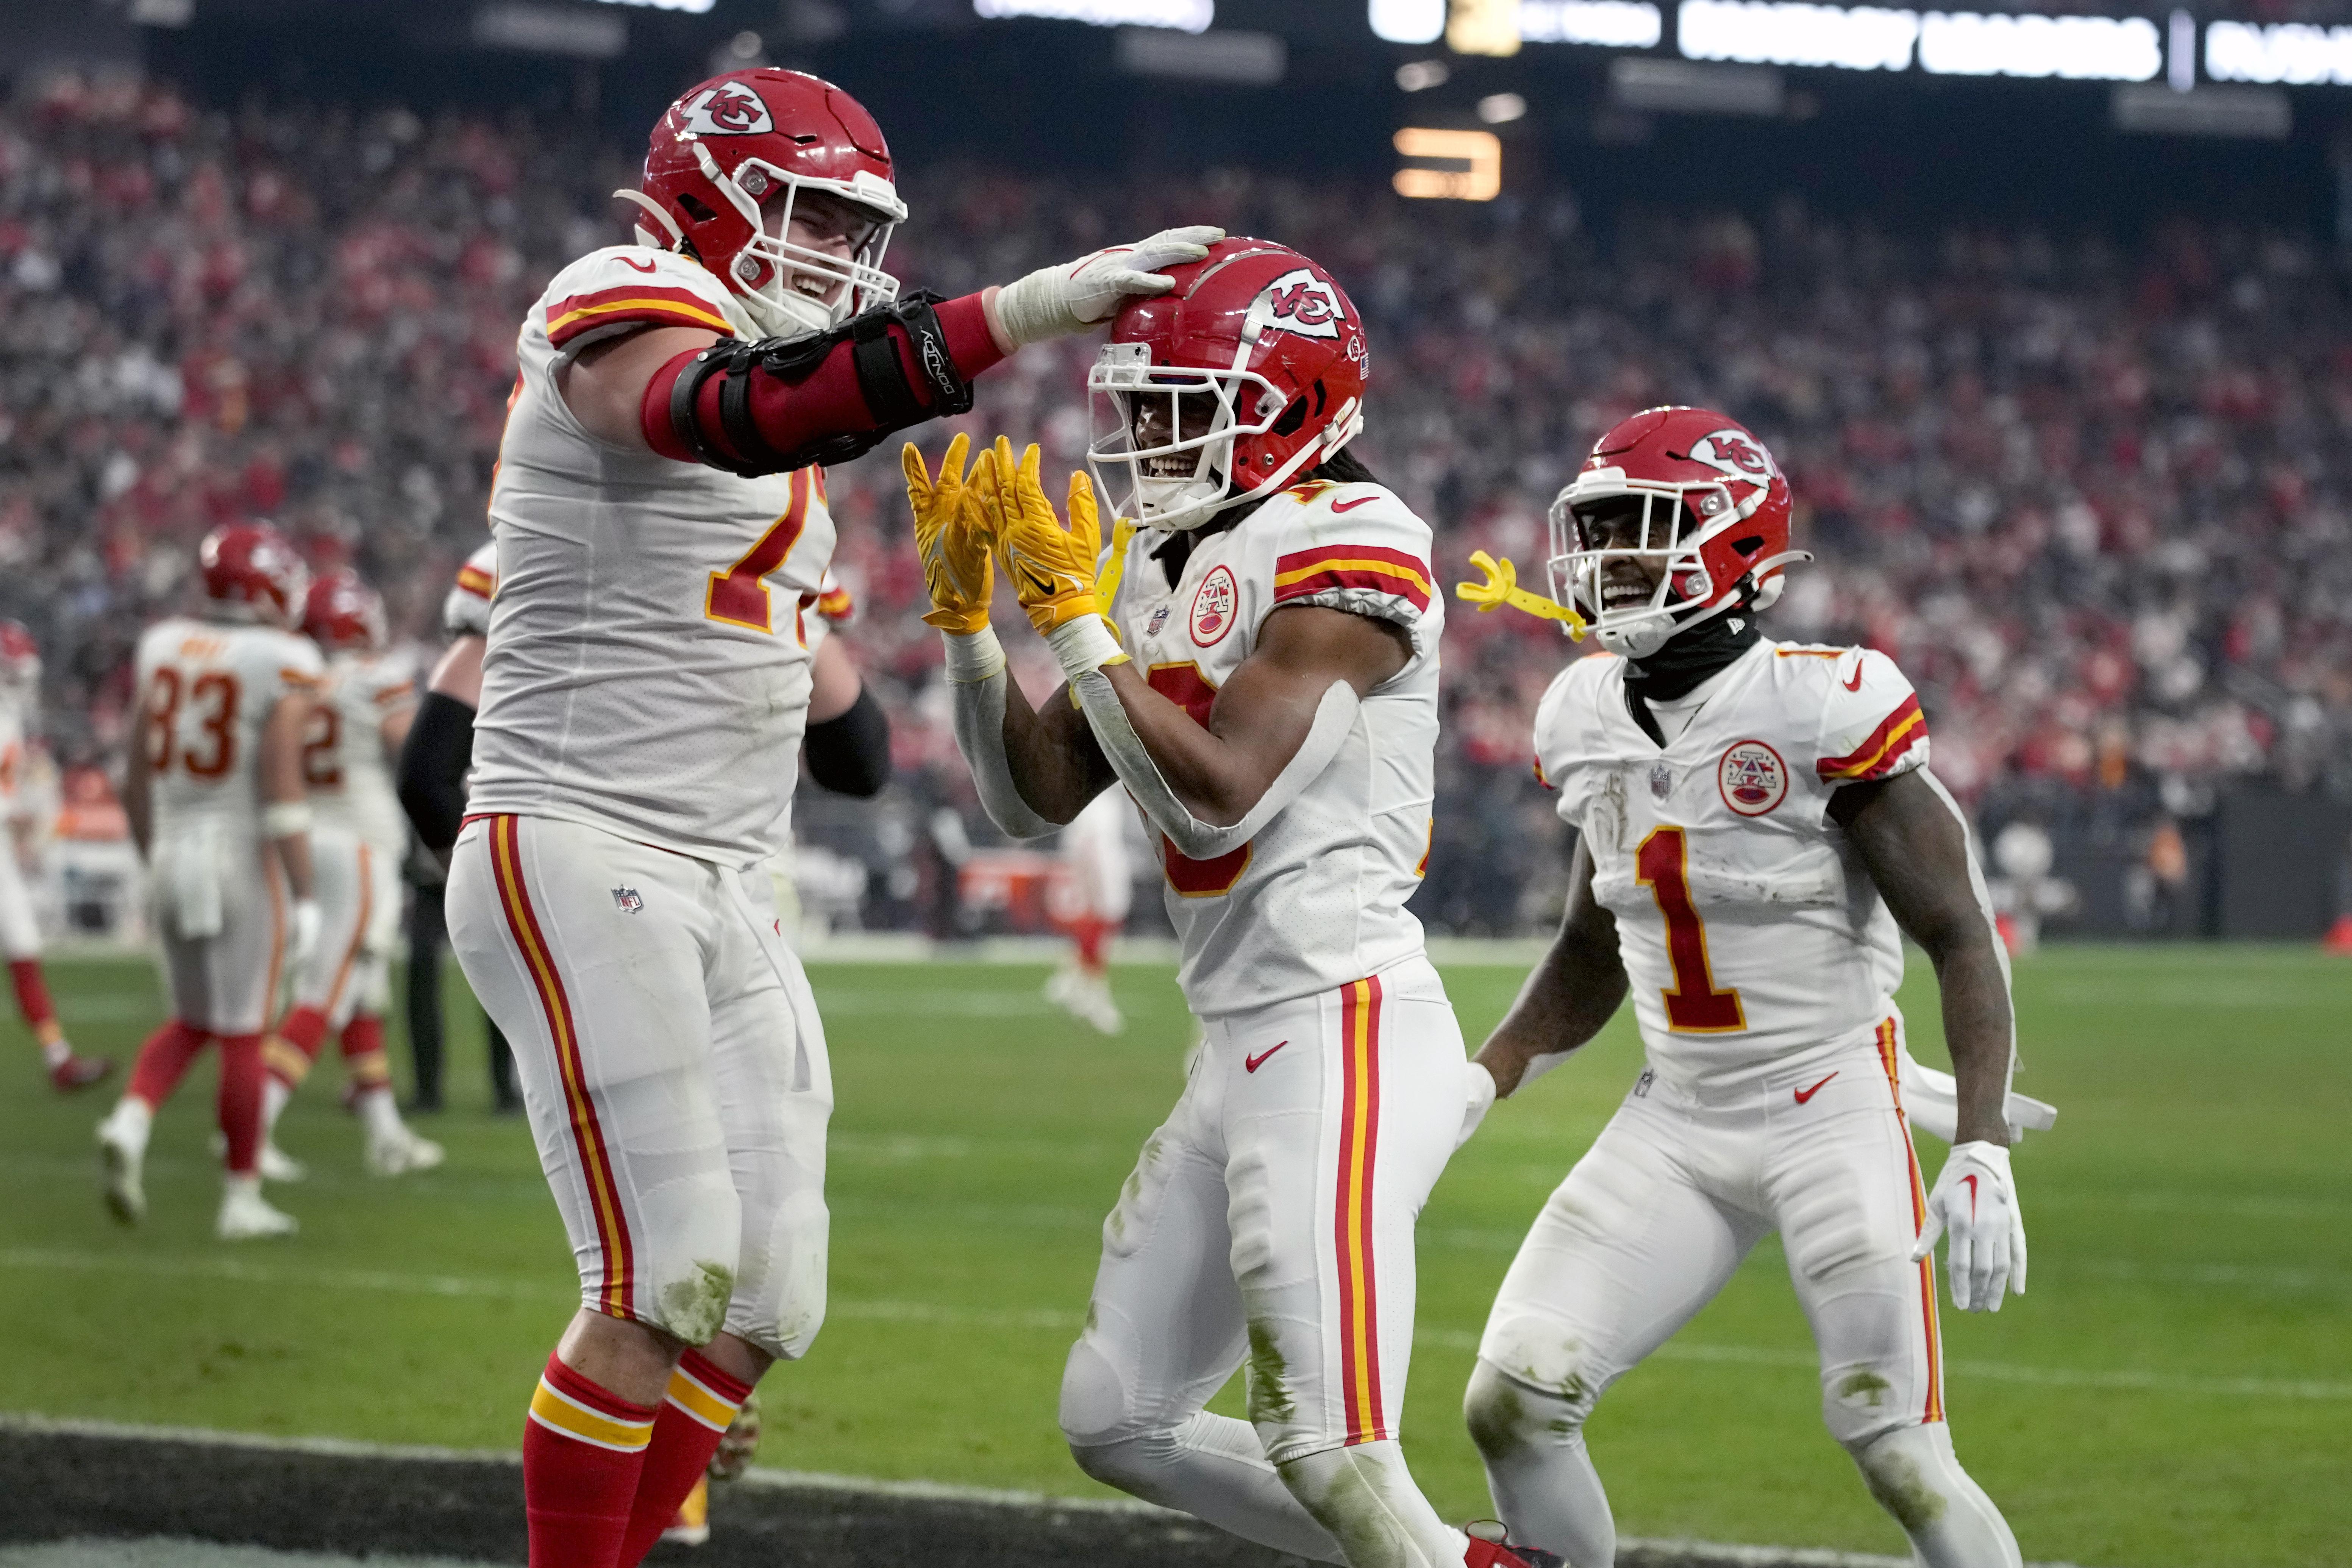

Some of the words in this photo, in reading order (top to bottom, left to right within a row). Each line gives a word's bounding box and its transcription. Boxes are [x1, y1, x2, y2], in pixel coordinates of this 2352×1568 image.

[701, 89, 764, 131] KC
[1271, 282, 1334, 325] KC
[1707, 437, 1766, 473] KC
[1196, 576, 1228, 617] A
[1727, 751, 1777, 788] A
[1635, 825, 1747, 1033] 1
